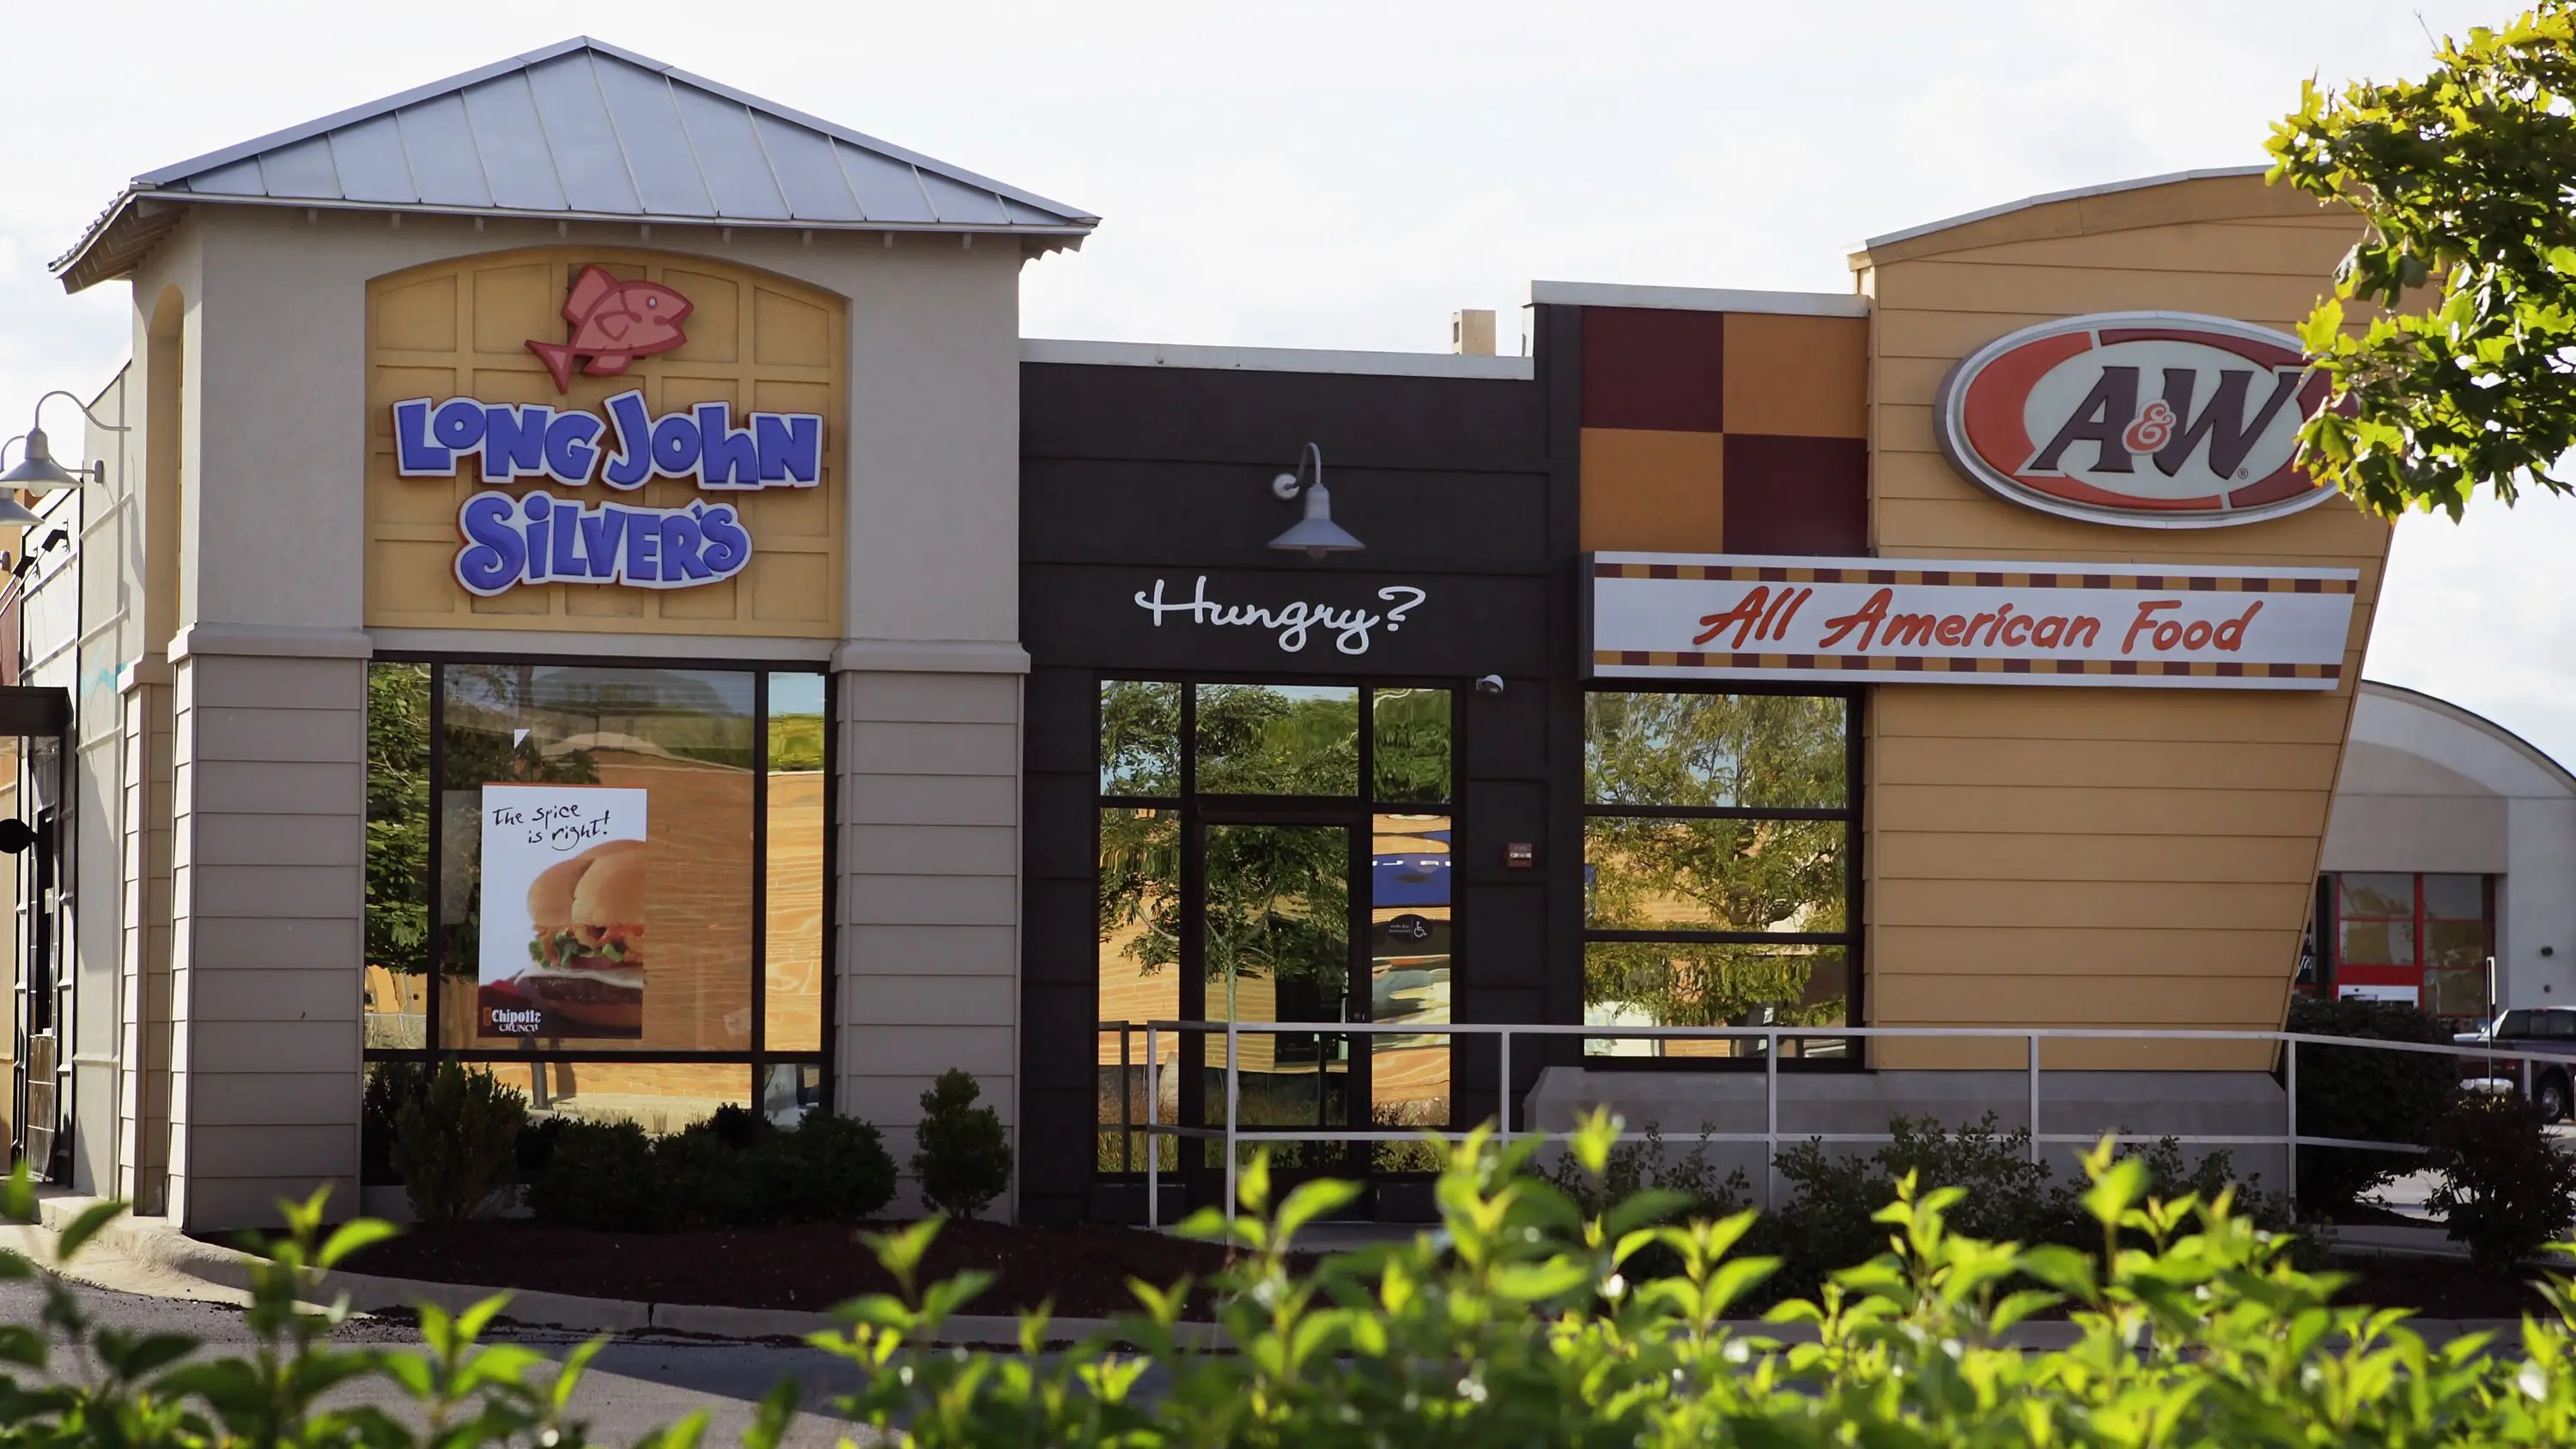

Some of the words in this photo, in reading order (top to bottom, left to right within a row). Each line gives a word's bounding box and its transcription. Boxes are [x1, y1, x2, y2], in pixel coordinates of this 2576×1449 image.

[1134, 575, 1426, 655] Hungry?
[1692, 585, 1813, 650] All
[1819, 587, 2101, 652] American
[2121, 599, 2263, 655] Food
[492, 806, 525, 826] The
[532, 803, 581, 830] spice
[528, 829, 543, 844] is
[550, 809, 611, 852] right!
[491, 1009, 542, 1025] Chipotle
